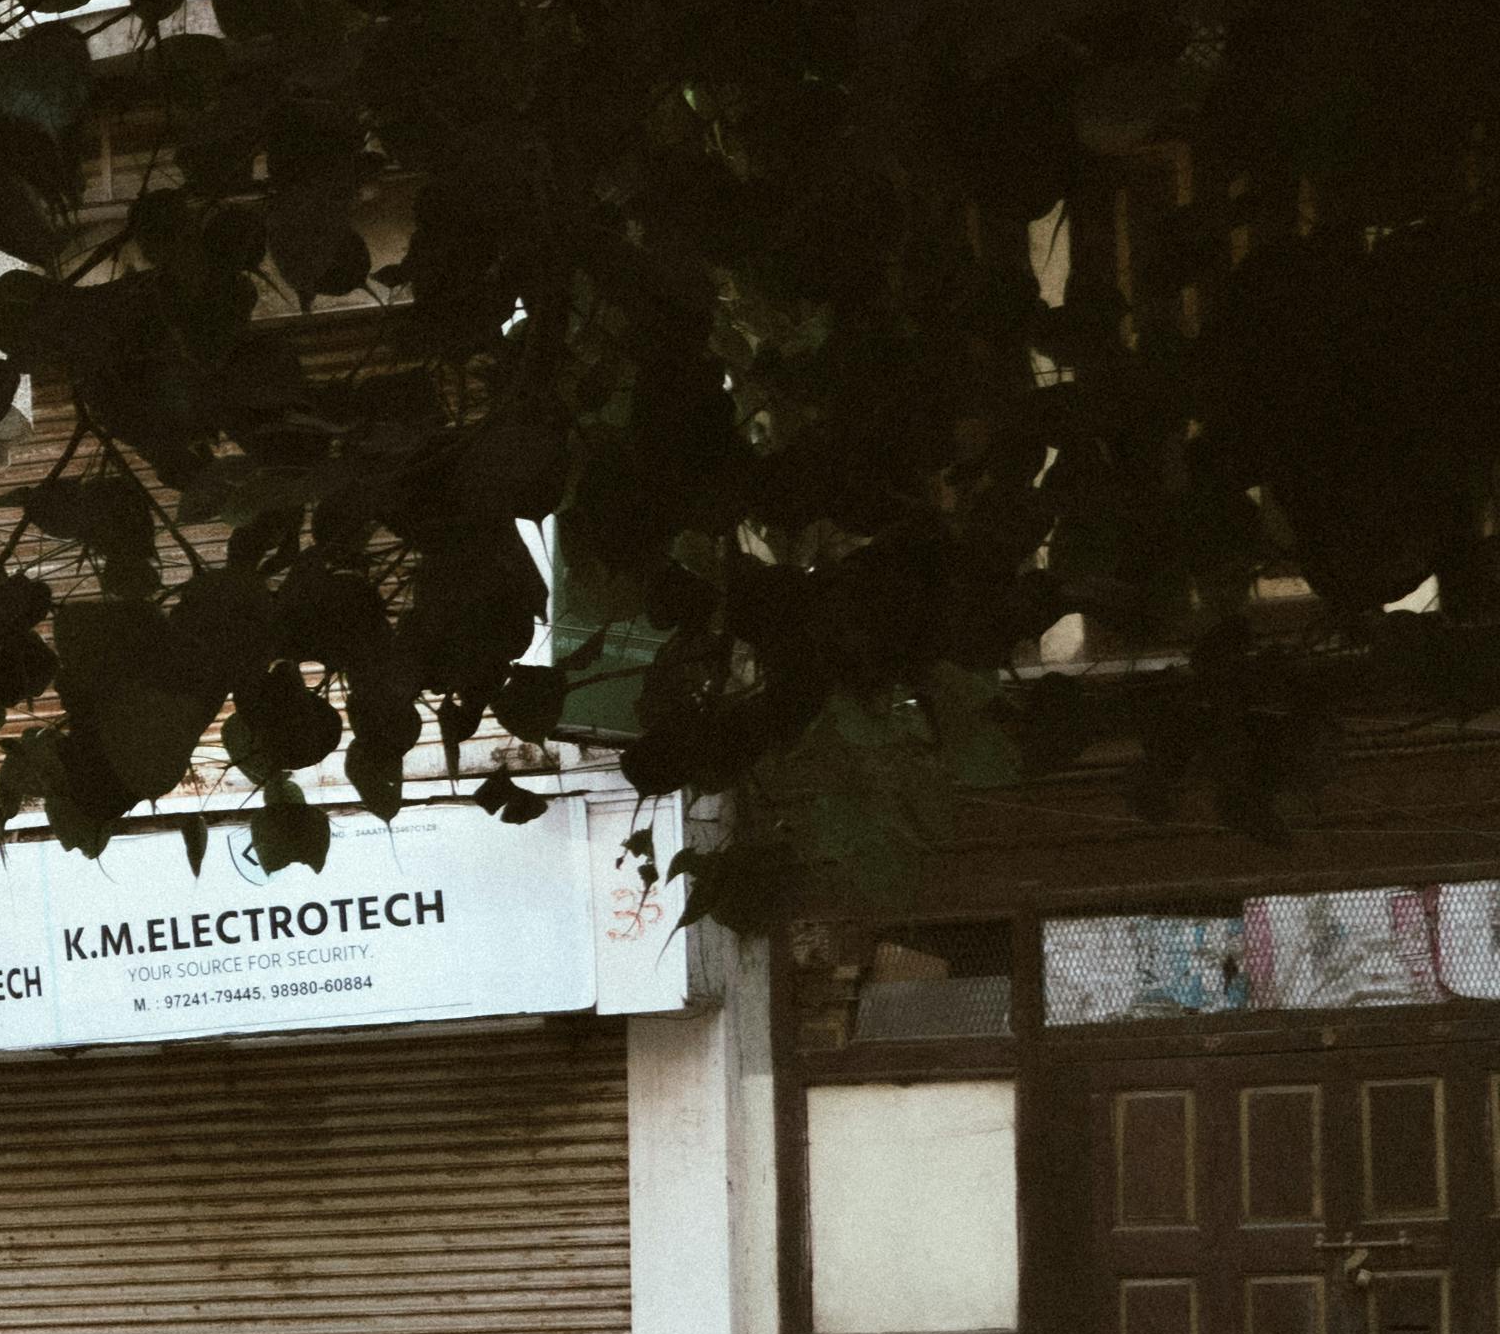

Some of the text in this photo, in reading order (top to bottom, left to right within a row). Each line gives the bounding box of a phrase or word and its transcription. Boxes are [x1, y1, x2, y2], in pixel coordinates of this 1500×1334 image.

[63, 889, 445, 961] K.M.ELECTROTECH
[127, 944, 375, 982] YOUR SOURCE FOR SECURITY.
[164, 987, 266, 1009] 97241-79445,
[270, 975, 373, 999] 98980-60884
